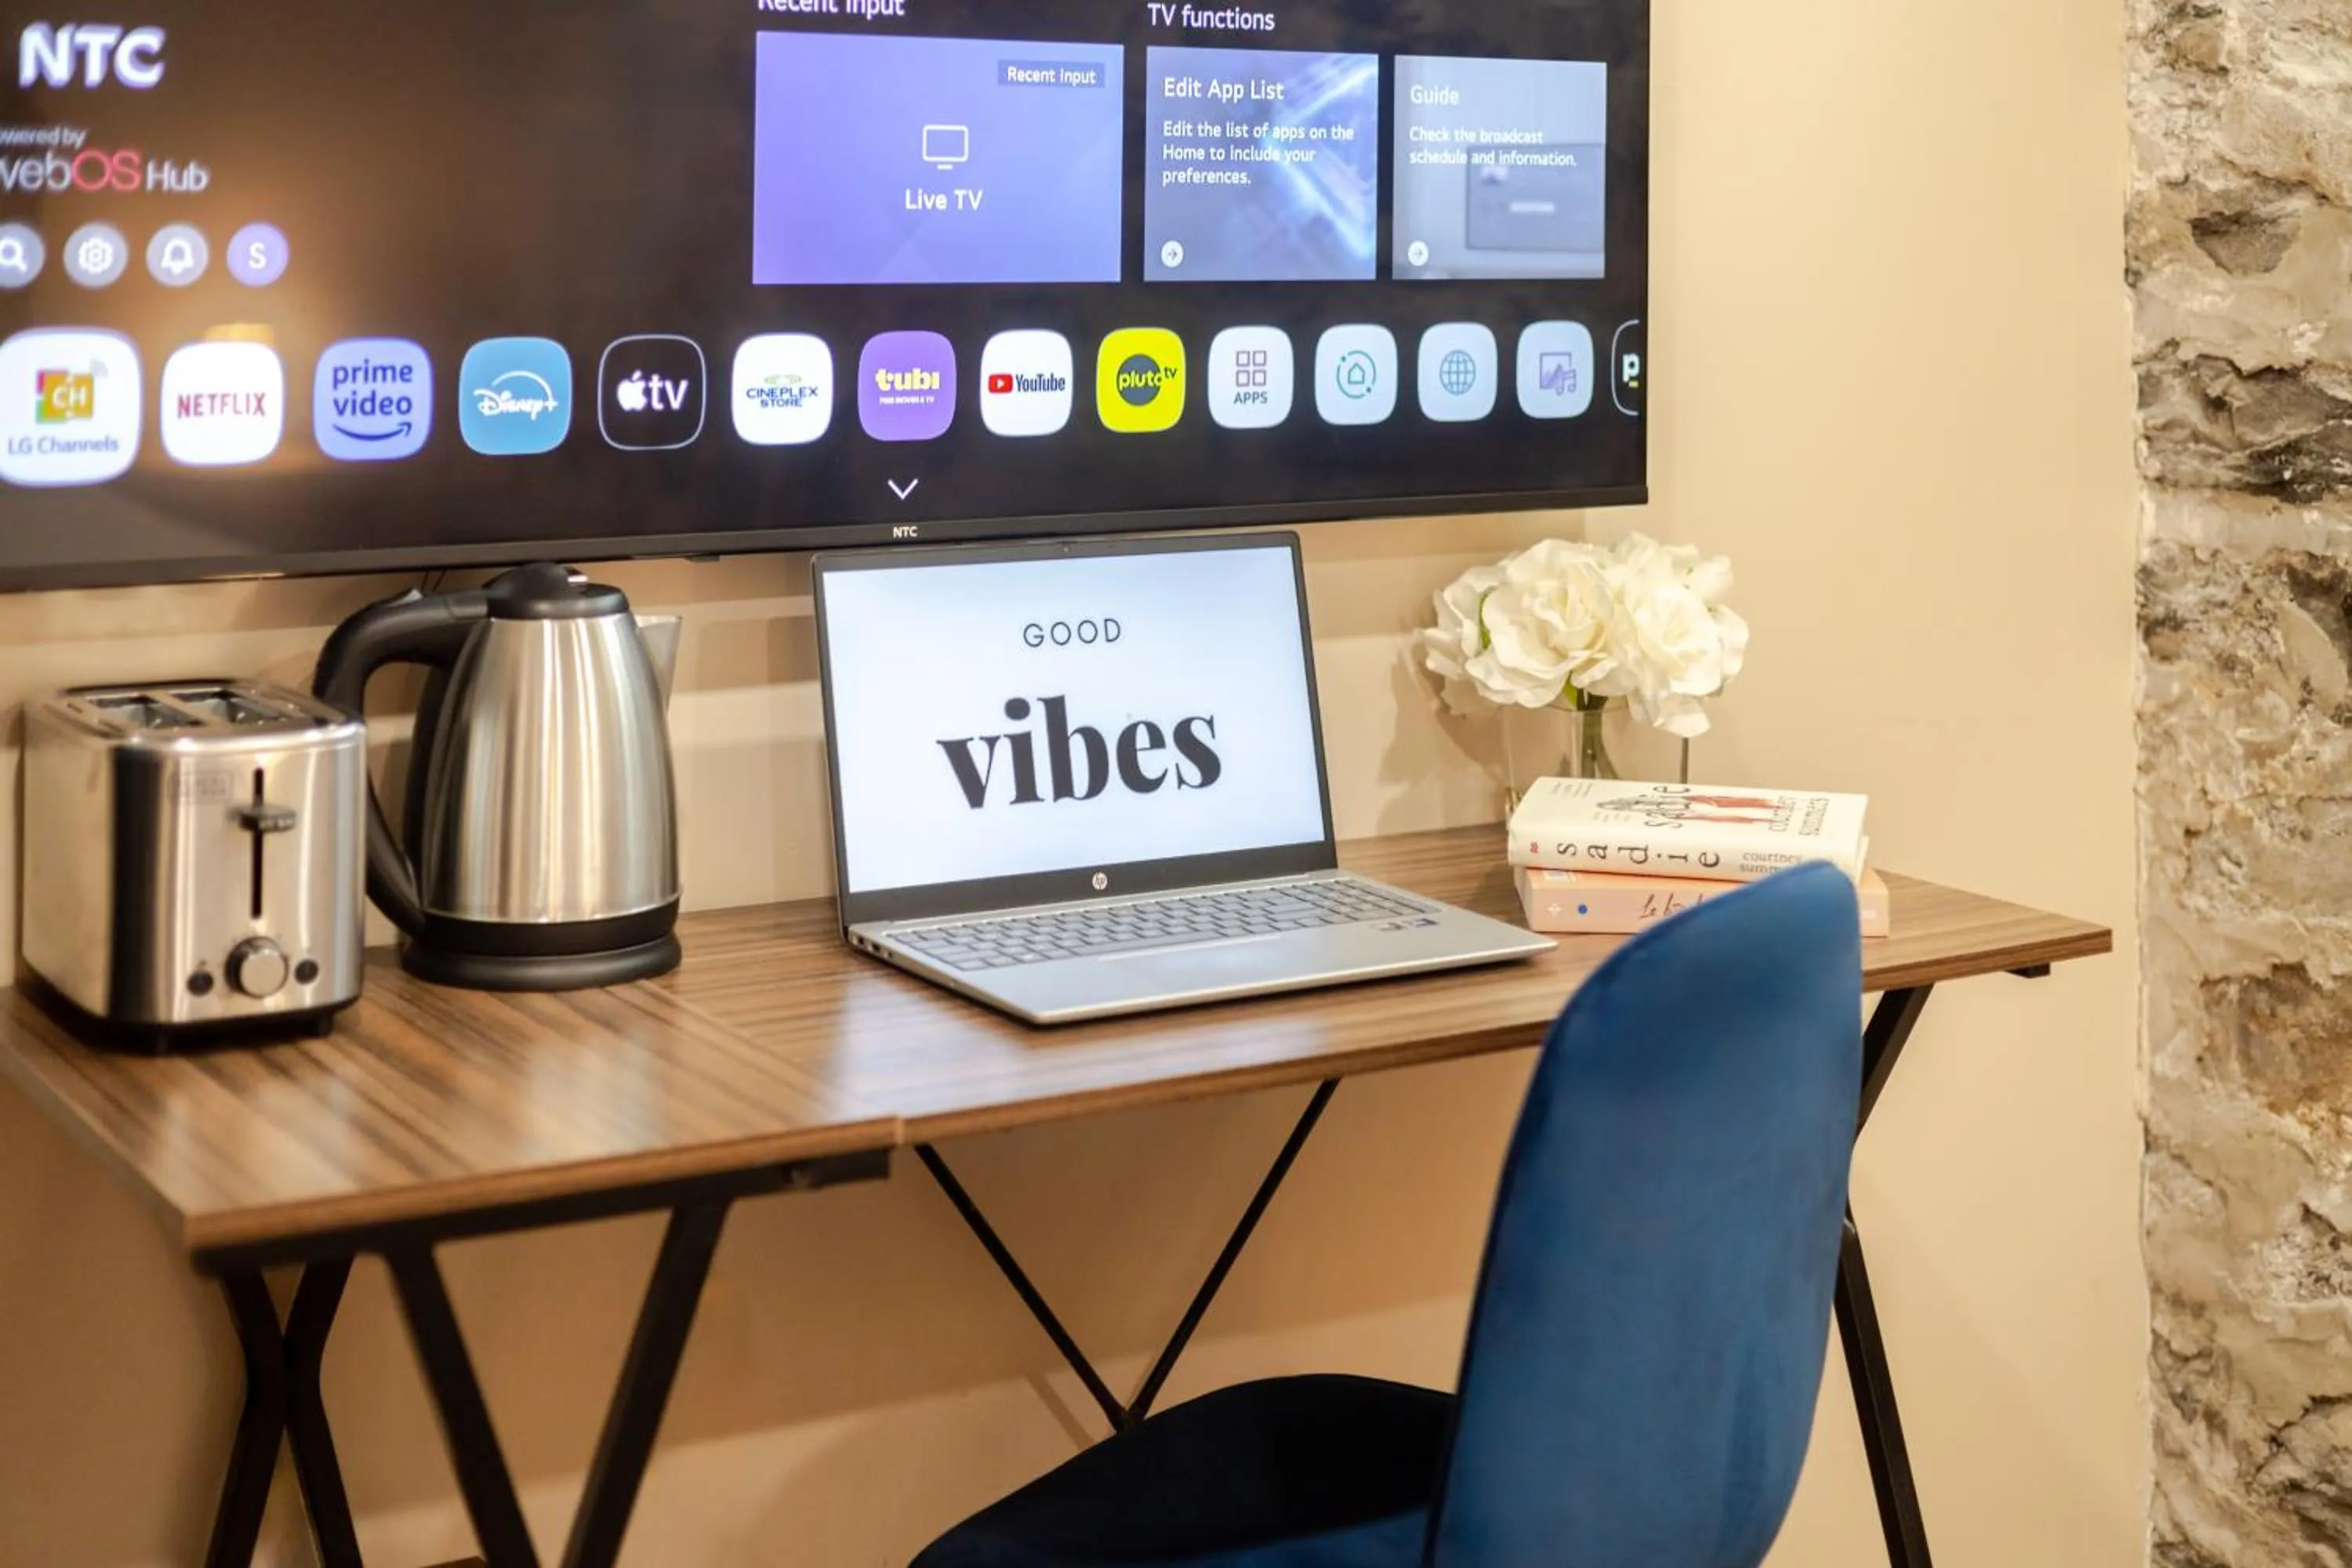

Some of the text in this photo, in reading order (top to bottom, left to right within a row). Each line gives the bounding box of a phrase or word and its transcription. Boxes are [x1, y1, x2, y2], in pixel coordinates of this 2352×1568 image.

[846, 0, 905, 20] Input
[1147, 3, 1275, 31] TV functions
[19, 21, 166, 88] NTC
[1007, 67, 1097, 87] Recent Input
[1163, 77, 1284, 103] Edit App List
[1410, 85, 1460, 105] Guide
[0, 127, 61, 144] wered
[1163, 121, 1354, 142] Edit the list of apps on the
[1410, 126, 1544, 144] Check the broadcast
[1163, 144, 1316, 165] Home to include your
[1409, 149, 1577, 166] schedule and information.
[147, 161, 209, 192] Hub
[1163, 167, 1252, 186] preferences.
[905, 189, 983, 211] Live TV
[248, 242, 267, 270] S
[332, 359, 414, 390] prime
[874, 368, 941, 391] tubi
[1014, 372, 1066, 393] YouTube
[1164, 366, 1178, 379] tv
[648, 372, 690, 412] tv
[746, 386, 818, 400] CINEPLEX
[1233, 391, 1269, 405] APPS
[177, 393, 266, 419] NETFLIX
[332, 390, 414, 417] video
[8, 434, 119, 456] LG Channels
[893, 526, 918, 539] NTC
[1022, 617, 1123, 649] GOOD
[935, 693, 1223, 811] vibes
[1556, 840, 1722, 869] sadie
